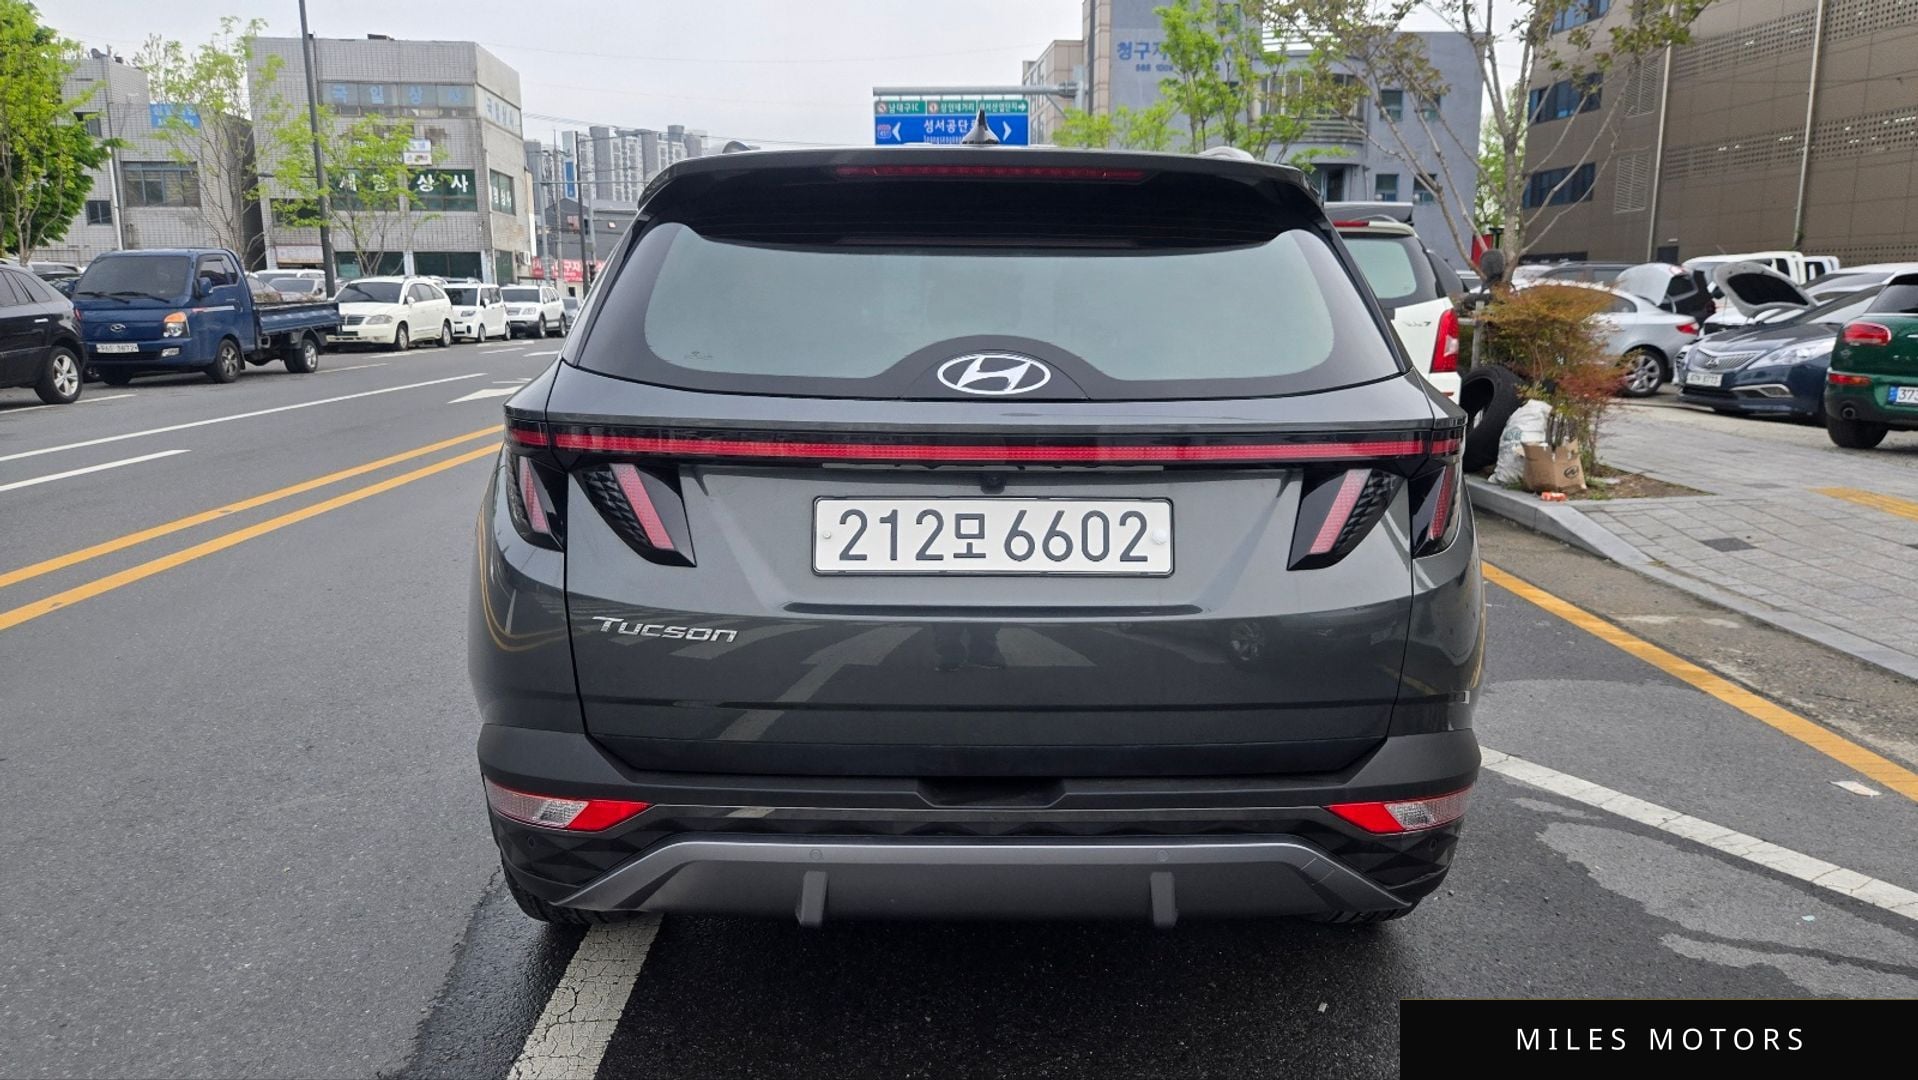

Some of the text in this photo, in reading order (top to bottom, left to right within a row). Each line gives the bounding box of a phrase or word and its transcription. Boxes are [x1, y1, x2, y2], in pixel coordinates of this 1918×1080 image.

[888, 101, 919, 113] 남대구IC
[838, 508, 1149, 563] 212모 6602
